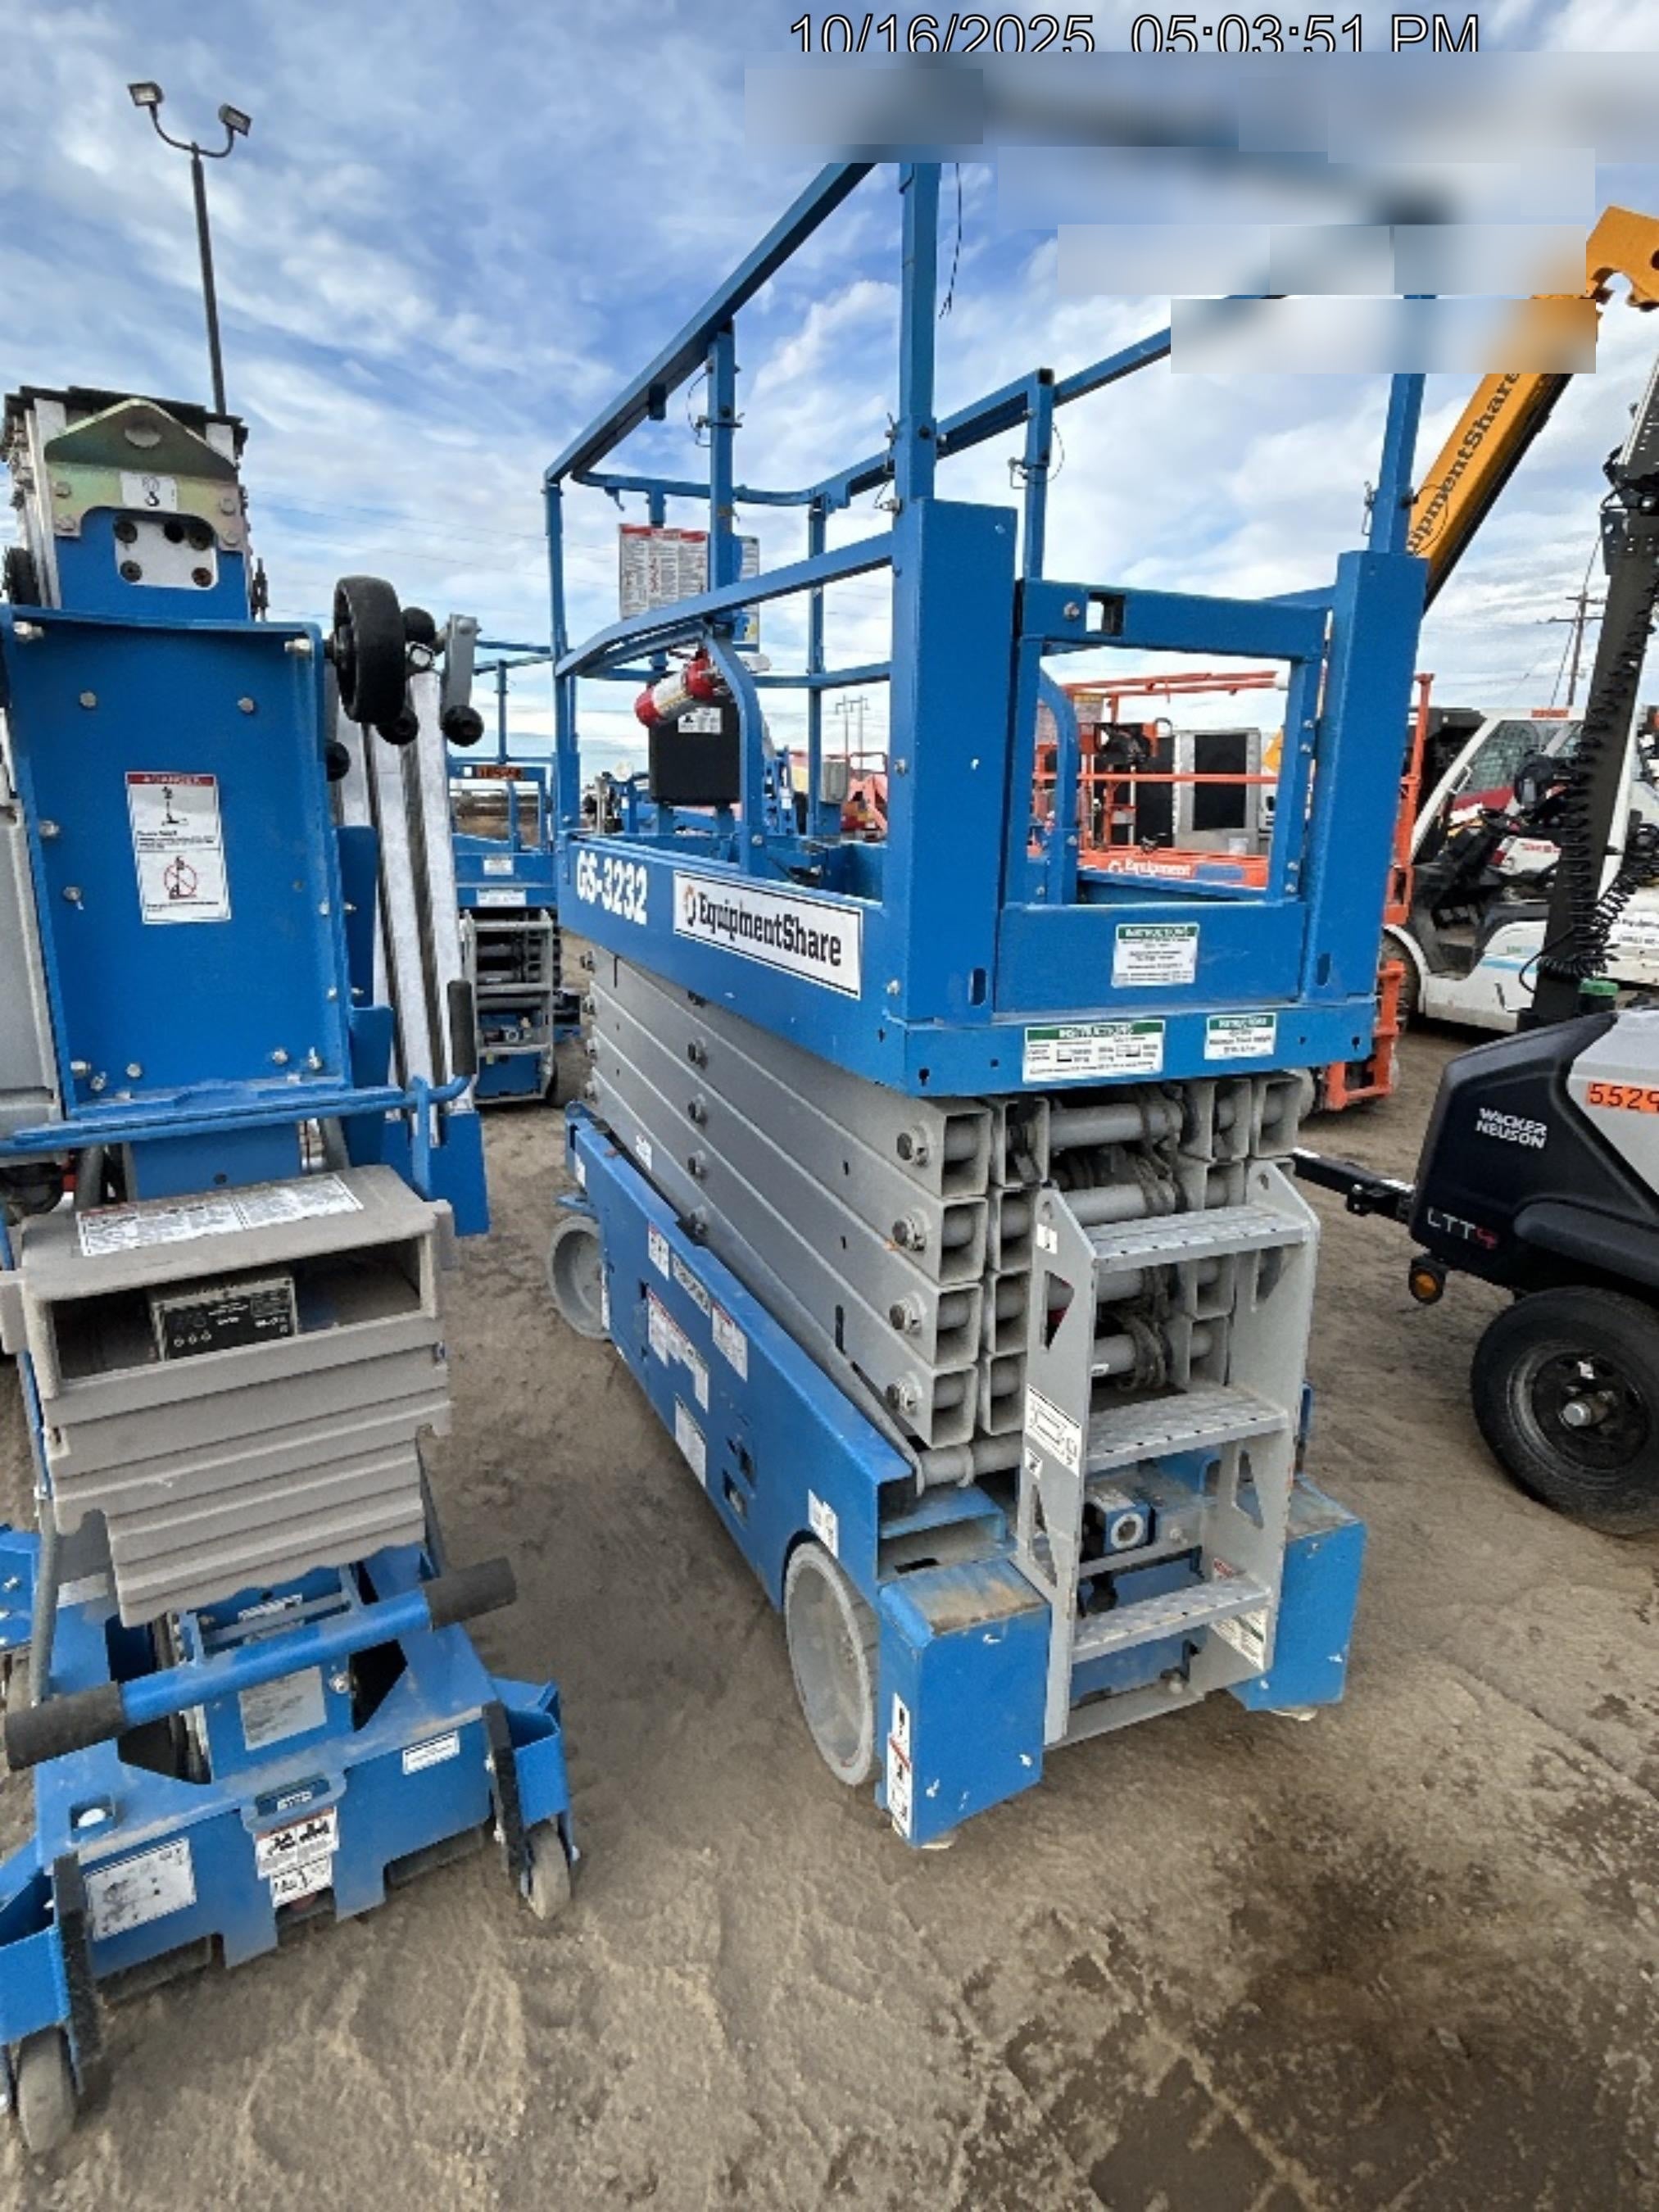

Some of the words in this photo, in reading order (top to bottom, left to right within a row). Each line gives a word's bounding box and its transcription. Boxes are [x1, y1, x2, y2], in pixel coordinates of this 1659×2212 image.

[577, 850, 647, 926] GS-3232
[698, 891, 842, 967] EquipmentShare
[1476, 1120, 1546, 1149] NEUSON
[1479, 1108, 1548, 1137] WACKER
